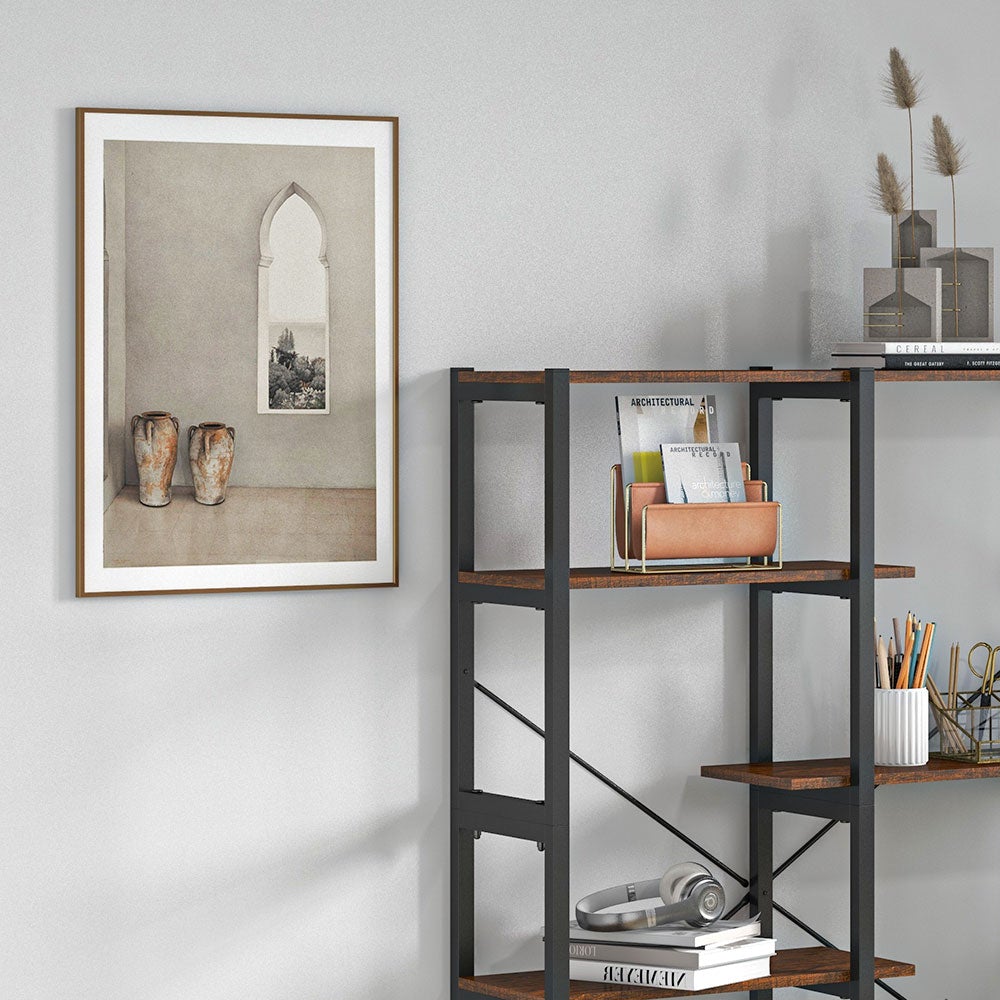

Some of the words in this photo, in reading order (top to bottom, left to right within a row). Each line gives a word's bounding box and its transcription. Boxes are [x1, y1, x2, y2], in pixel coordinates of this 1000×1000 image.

[896, 345, 945, 353] CEREAL
[631, 397, 695, 407] ARCHITECTURAL
[691, 476, 741, 490] architecture
